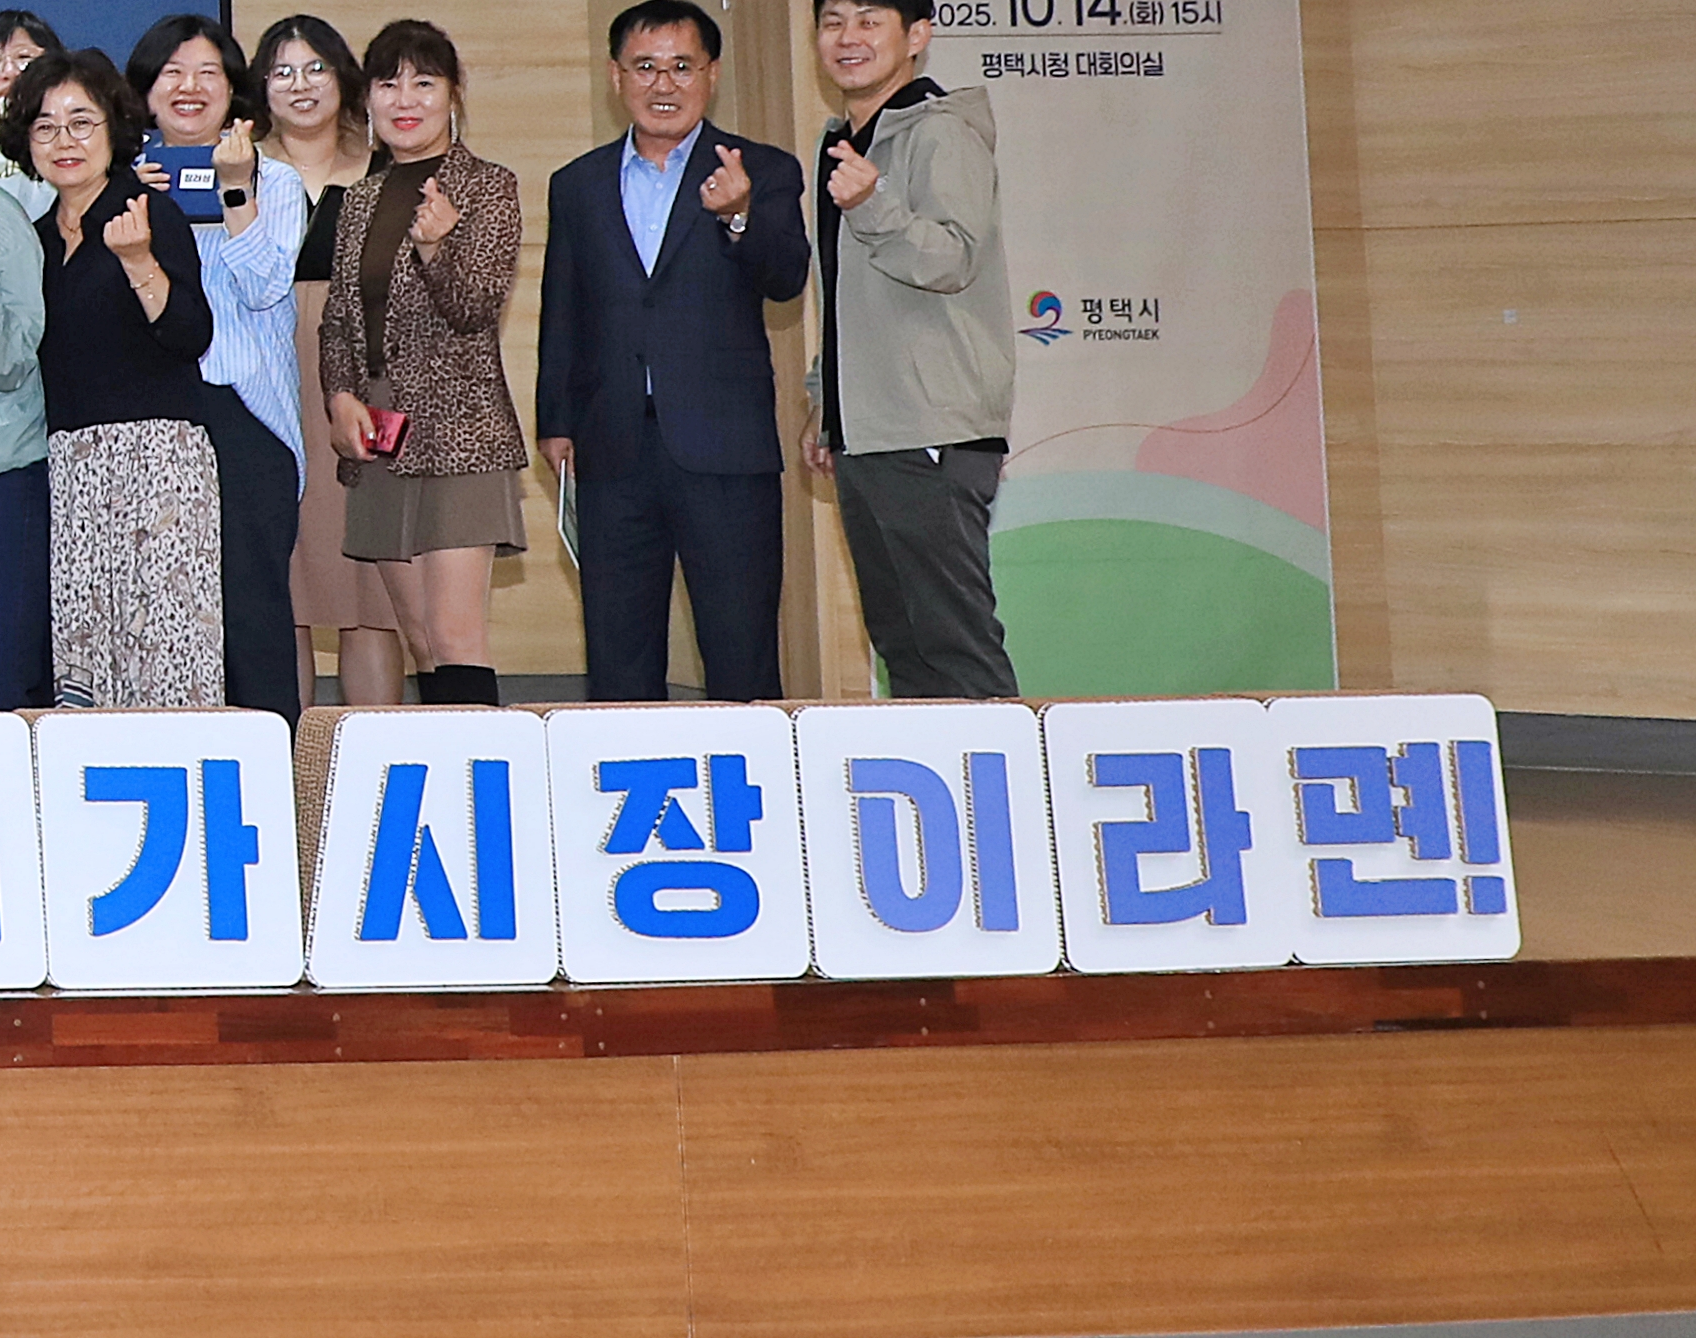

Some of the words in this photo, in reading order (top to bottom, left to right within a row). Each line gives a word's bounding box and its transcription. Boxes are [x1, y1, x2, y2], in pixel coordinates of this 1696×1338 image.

[1171, 0, 1223, 26] 15시
[981, 52, 1070, 79] 평택시청
[1076, 51, 1165, 78] 대회의실
[1080, 297, 1160, 325] 평택시
[1083, 328, 1160, 341] PYEONGTAEK
